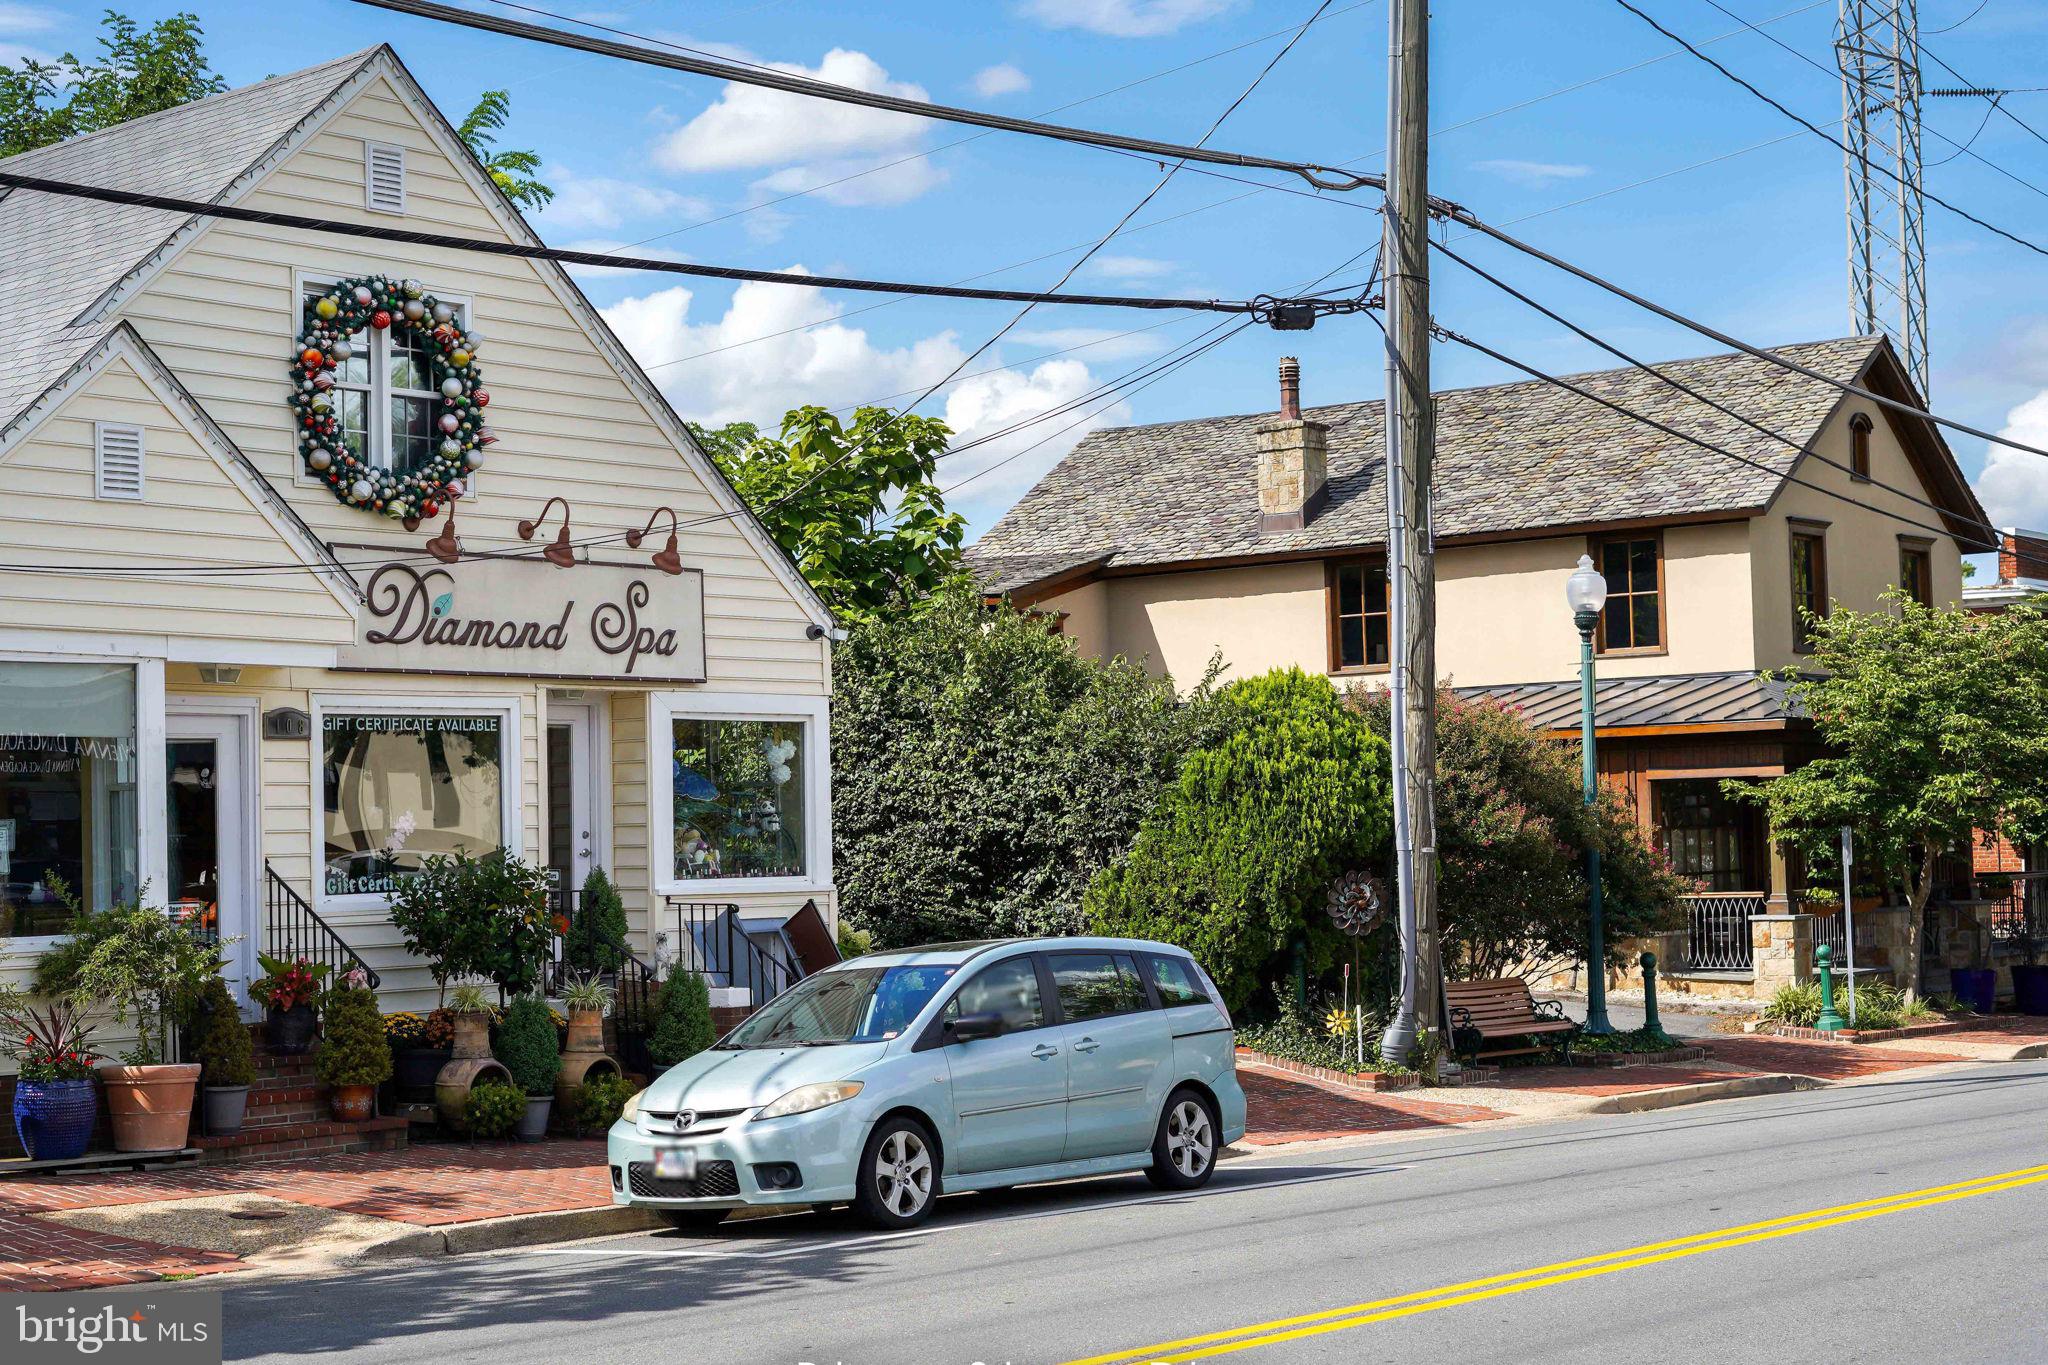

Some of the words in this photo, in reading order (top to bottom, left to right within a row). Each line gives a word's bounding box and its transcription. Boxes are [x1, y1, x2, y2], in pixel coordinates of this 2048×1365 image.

[366, 562, 575, 650] Diamond
[590, 580, 679, 673] Spa
[276, 718, 305, 736] 108
[323, 717, 351, 731] GIFT
[355, 718, 434, 731] CERTIFICATE
[438, 719, 498, 731] AVAILABLE
[326, 877, 357, 894] Gift
